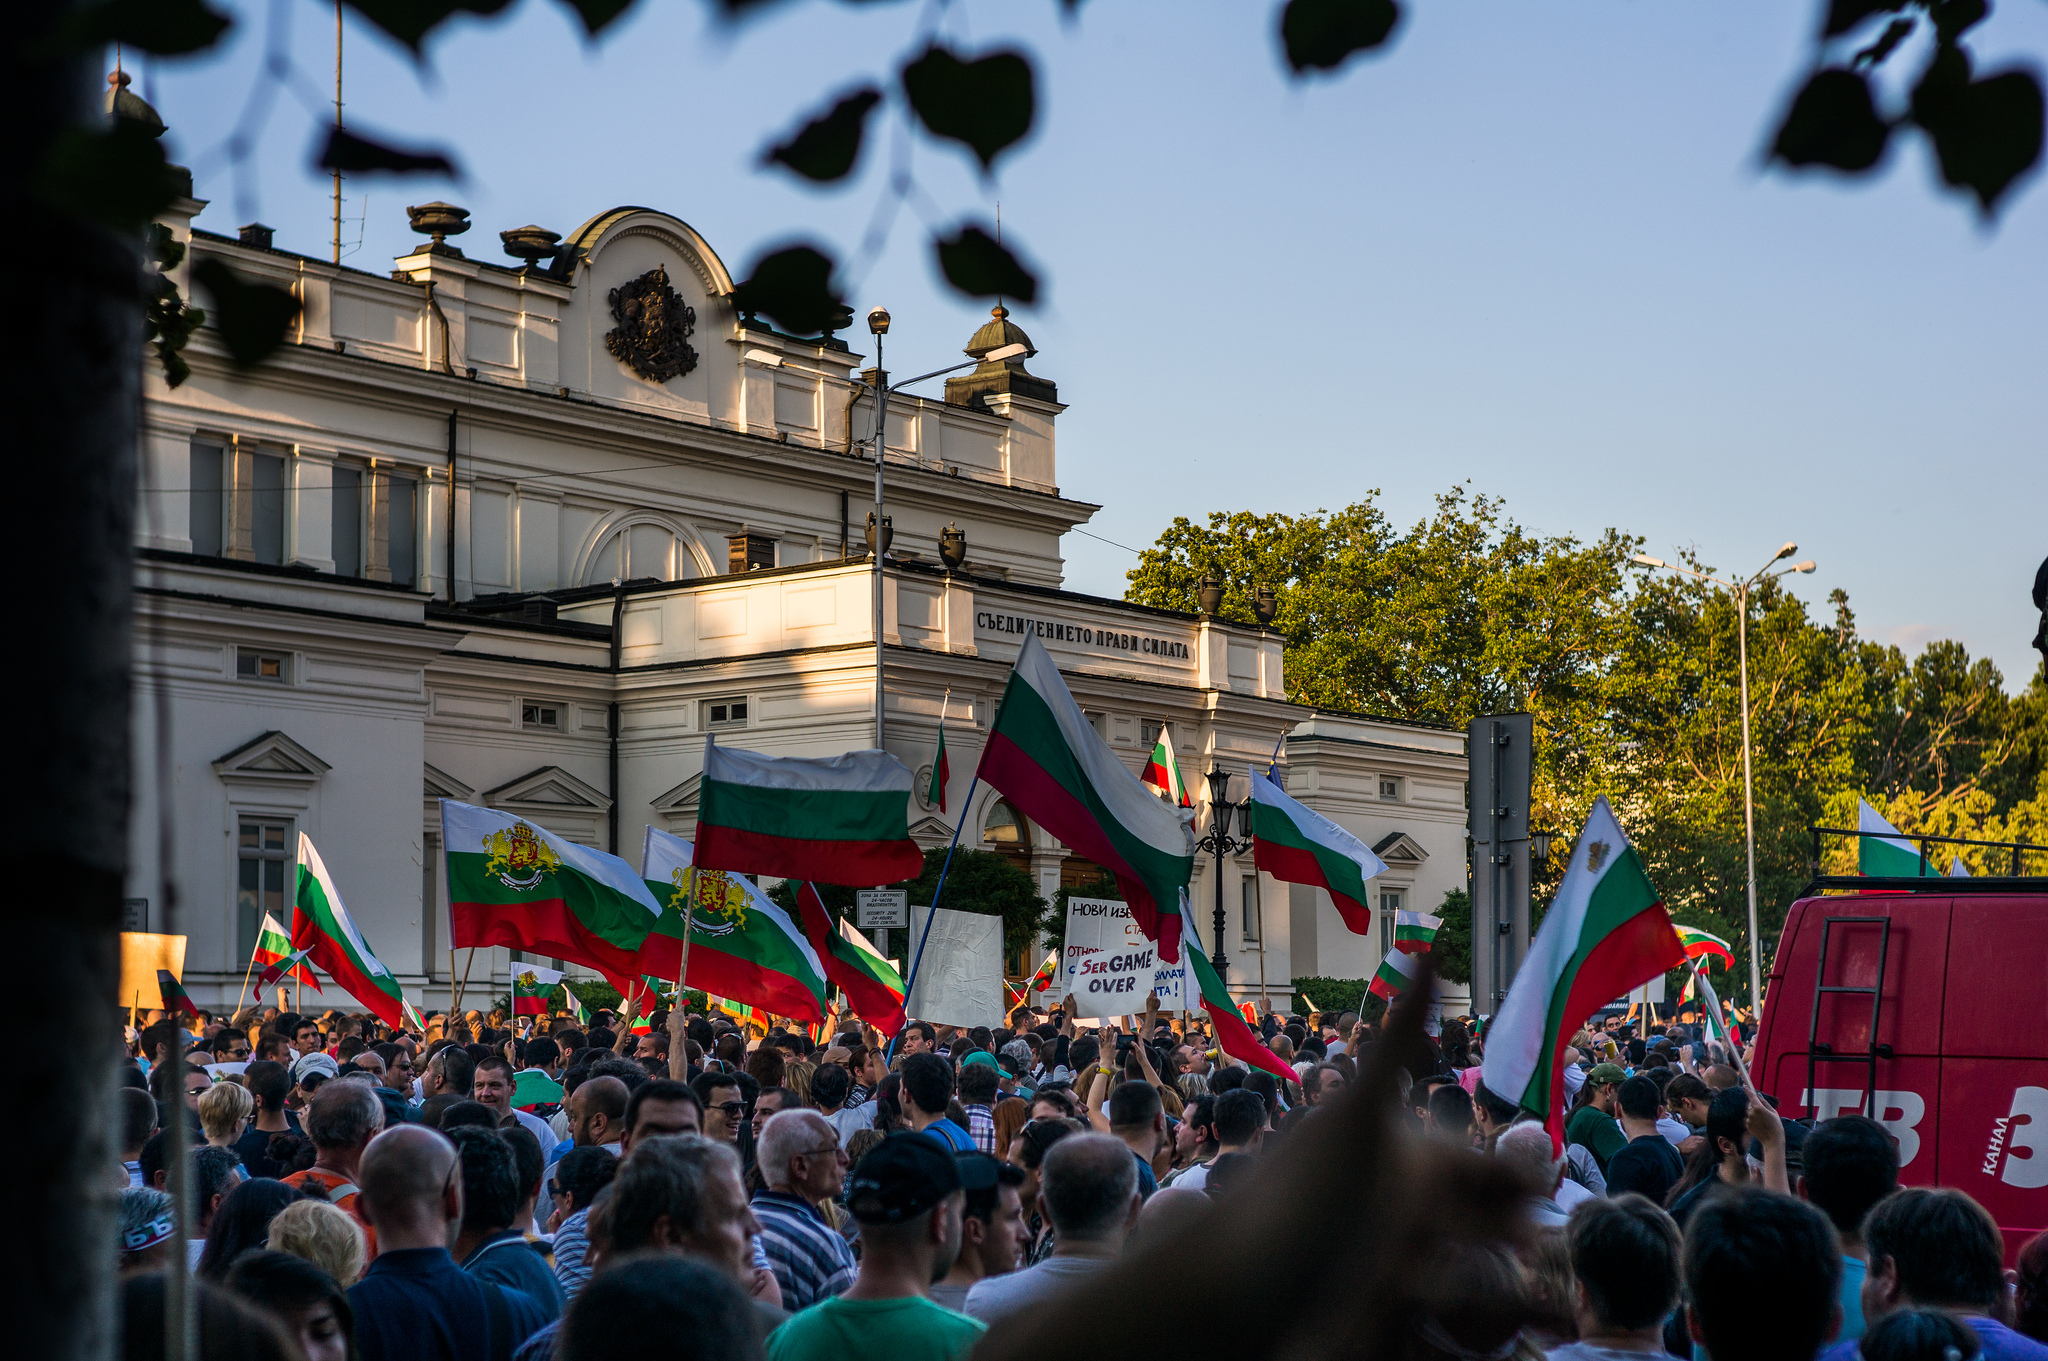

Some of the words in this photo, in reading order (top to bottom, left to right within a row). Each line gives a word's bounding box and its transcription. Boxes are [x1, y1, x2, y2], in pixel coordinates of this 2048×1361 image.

[1096, 630, 1138, 651] ПРАВИ
[1142, 637, 1189, 660] СИЛАТА
[1072, 903, 1107, 917] НОВИ
[1089, 976, 1136, 993] OVER
[1982, 1117, 2009, 1176] КАНАЛ
